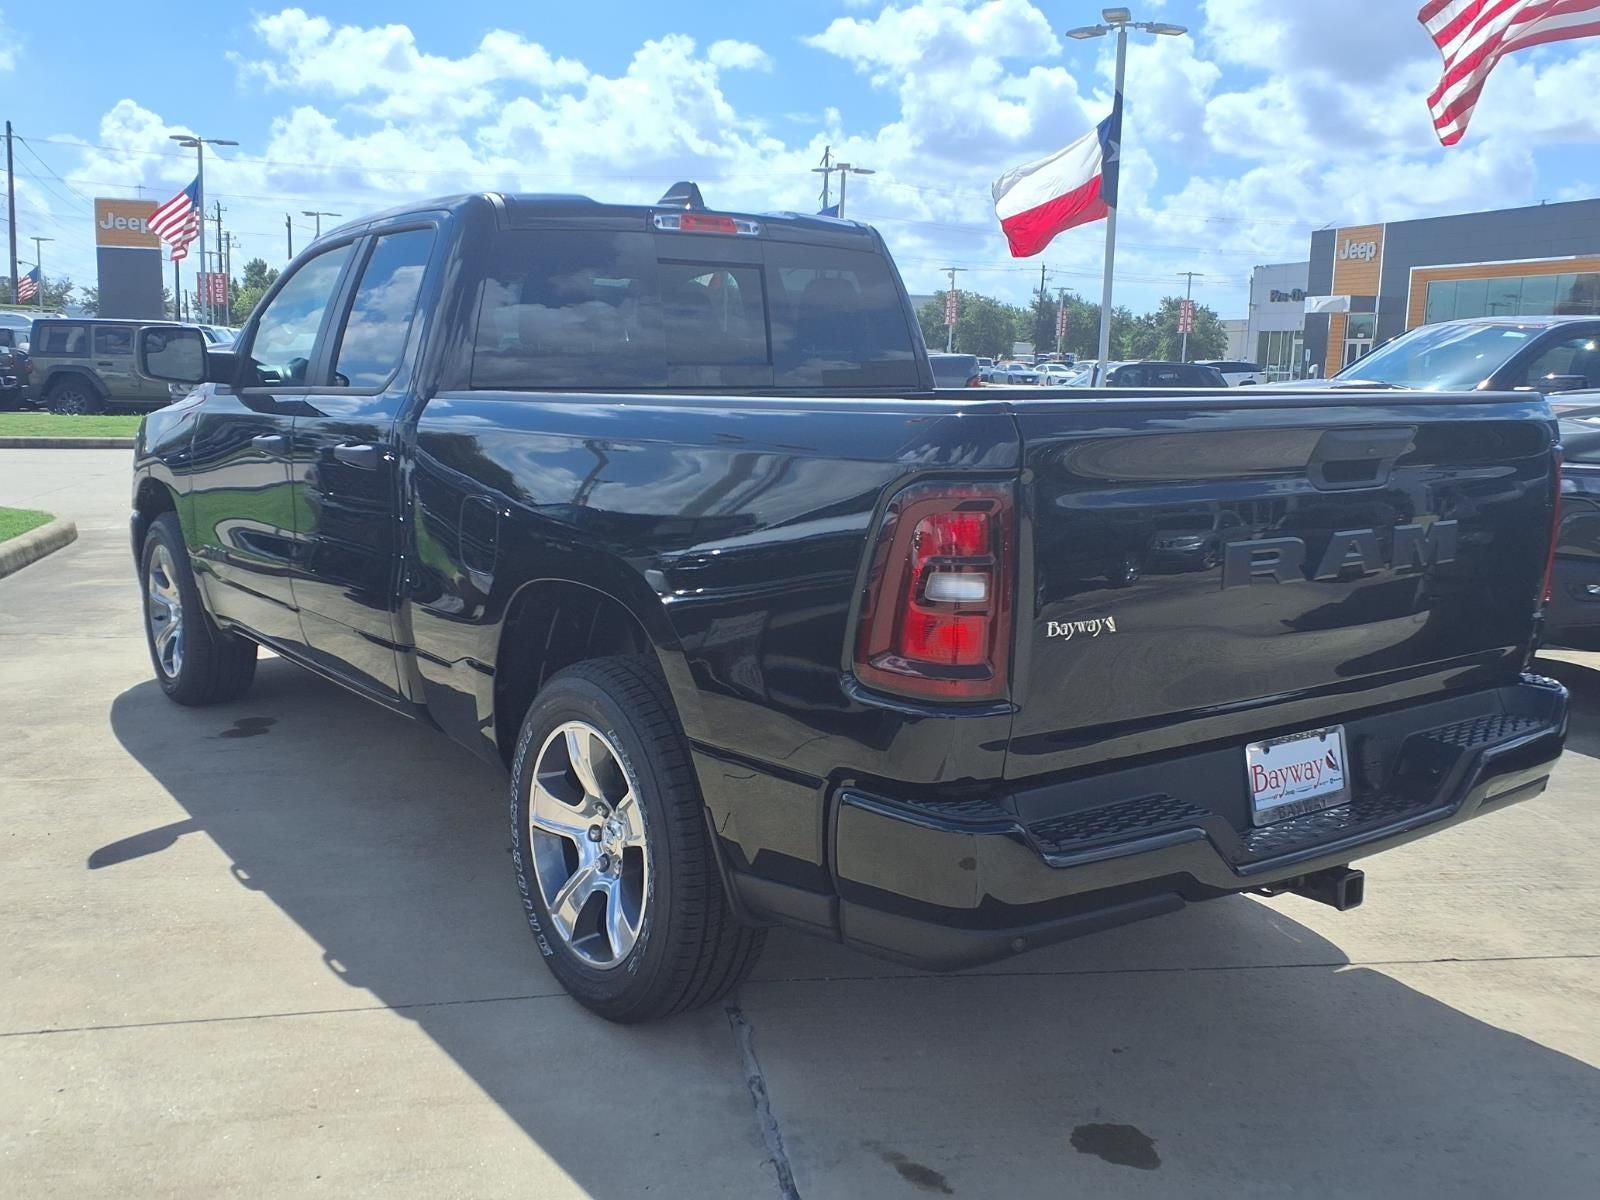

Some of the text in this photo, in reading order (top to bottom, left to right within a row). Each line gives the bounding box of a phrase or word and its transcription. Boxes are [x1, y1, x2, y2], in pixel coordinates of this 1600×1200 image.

[1339, 239, 1377, 261] Jeep
[215, 273, 225, 303] TRUCKS
[1221, 520, 1458, 590] RAM
[1046, 618, 1106, 641] Bayway
[1251, 758, 1323, 799] Bayway
